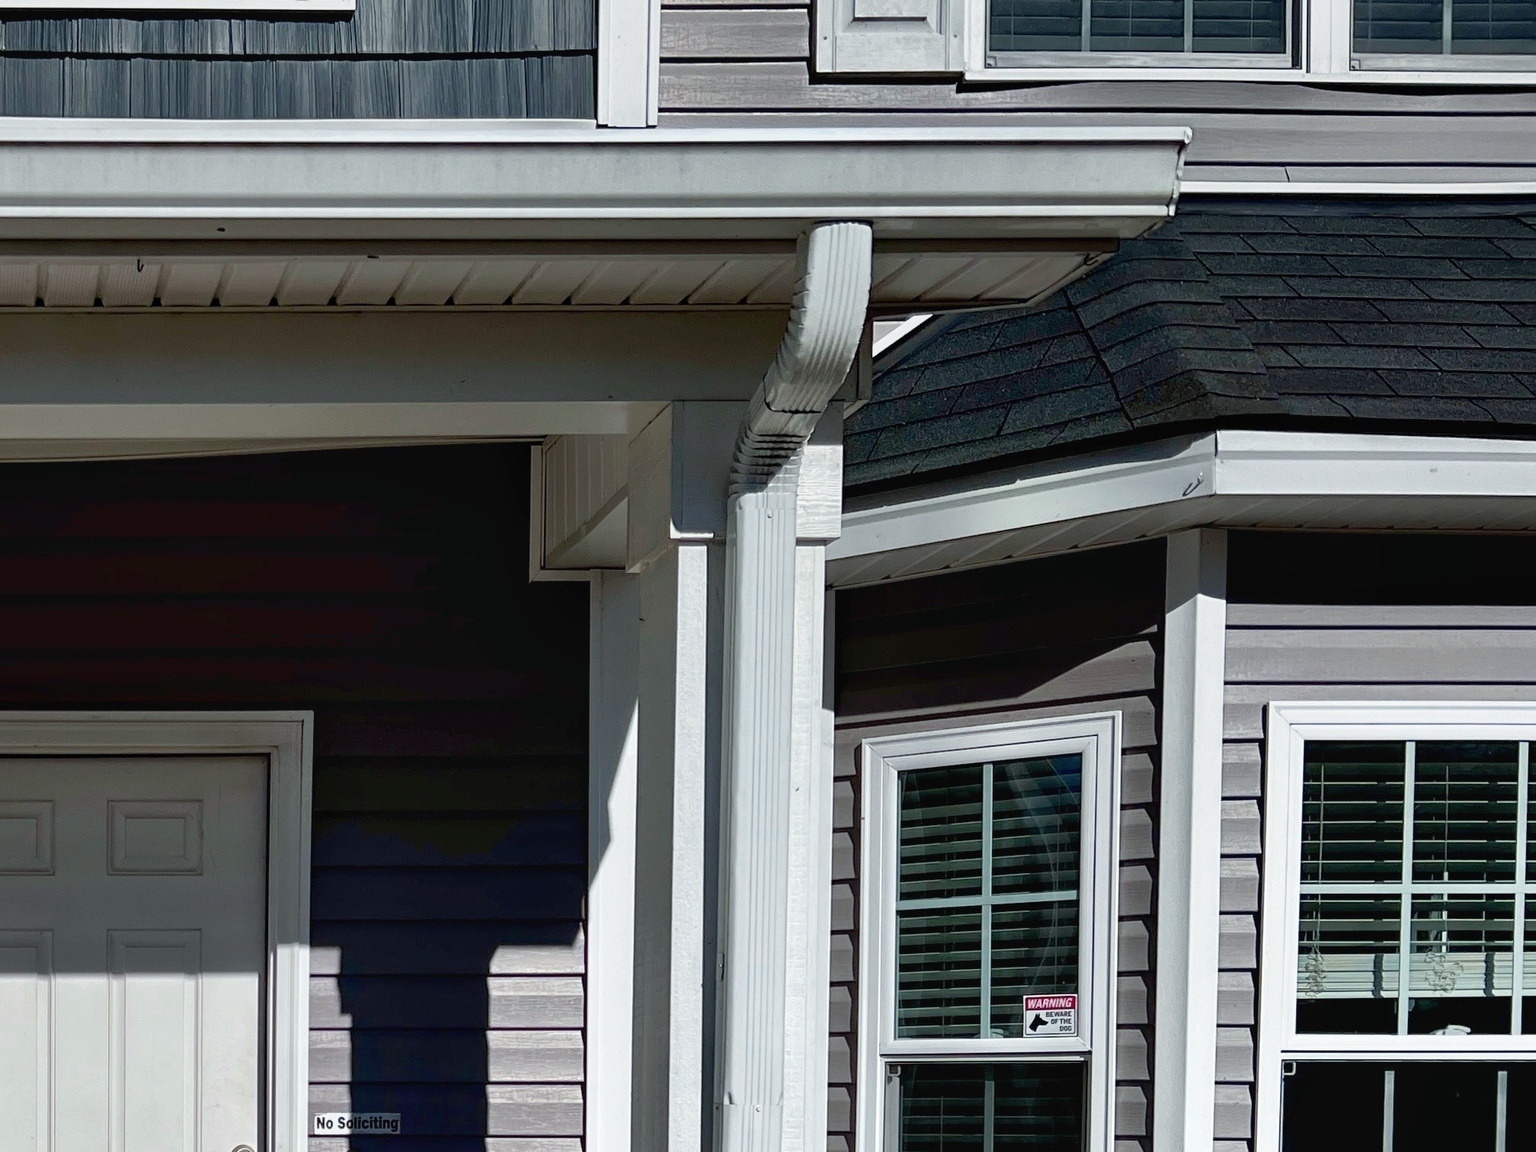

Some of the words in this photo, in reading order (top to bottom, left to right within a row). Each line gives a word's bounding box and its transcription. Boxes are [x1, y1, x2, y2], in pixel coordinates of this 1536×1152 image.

[1027, 998, 1073, 1009] WARNING
[316, 1116, 334, 1129] No
[337, 1115, 399, 1132] Soliciting
